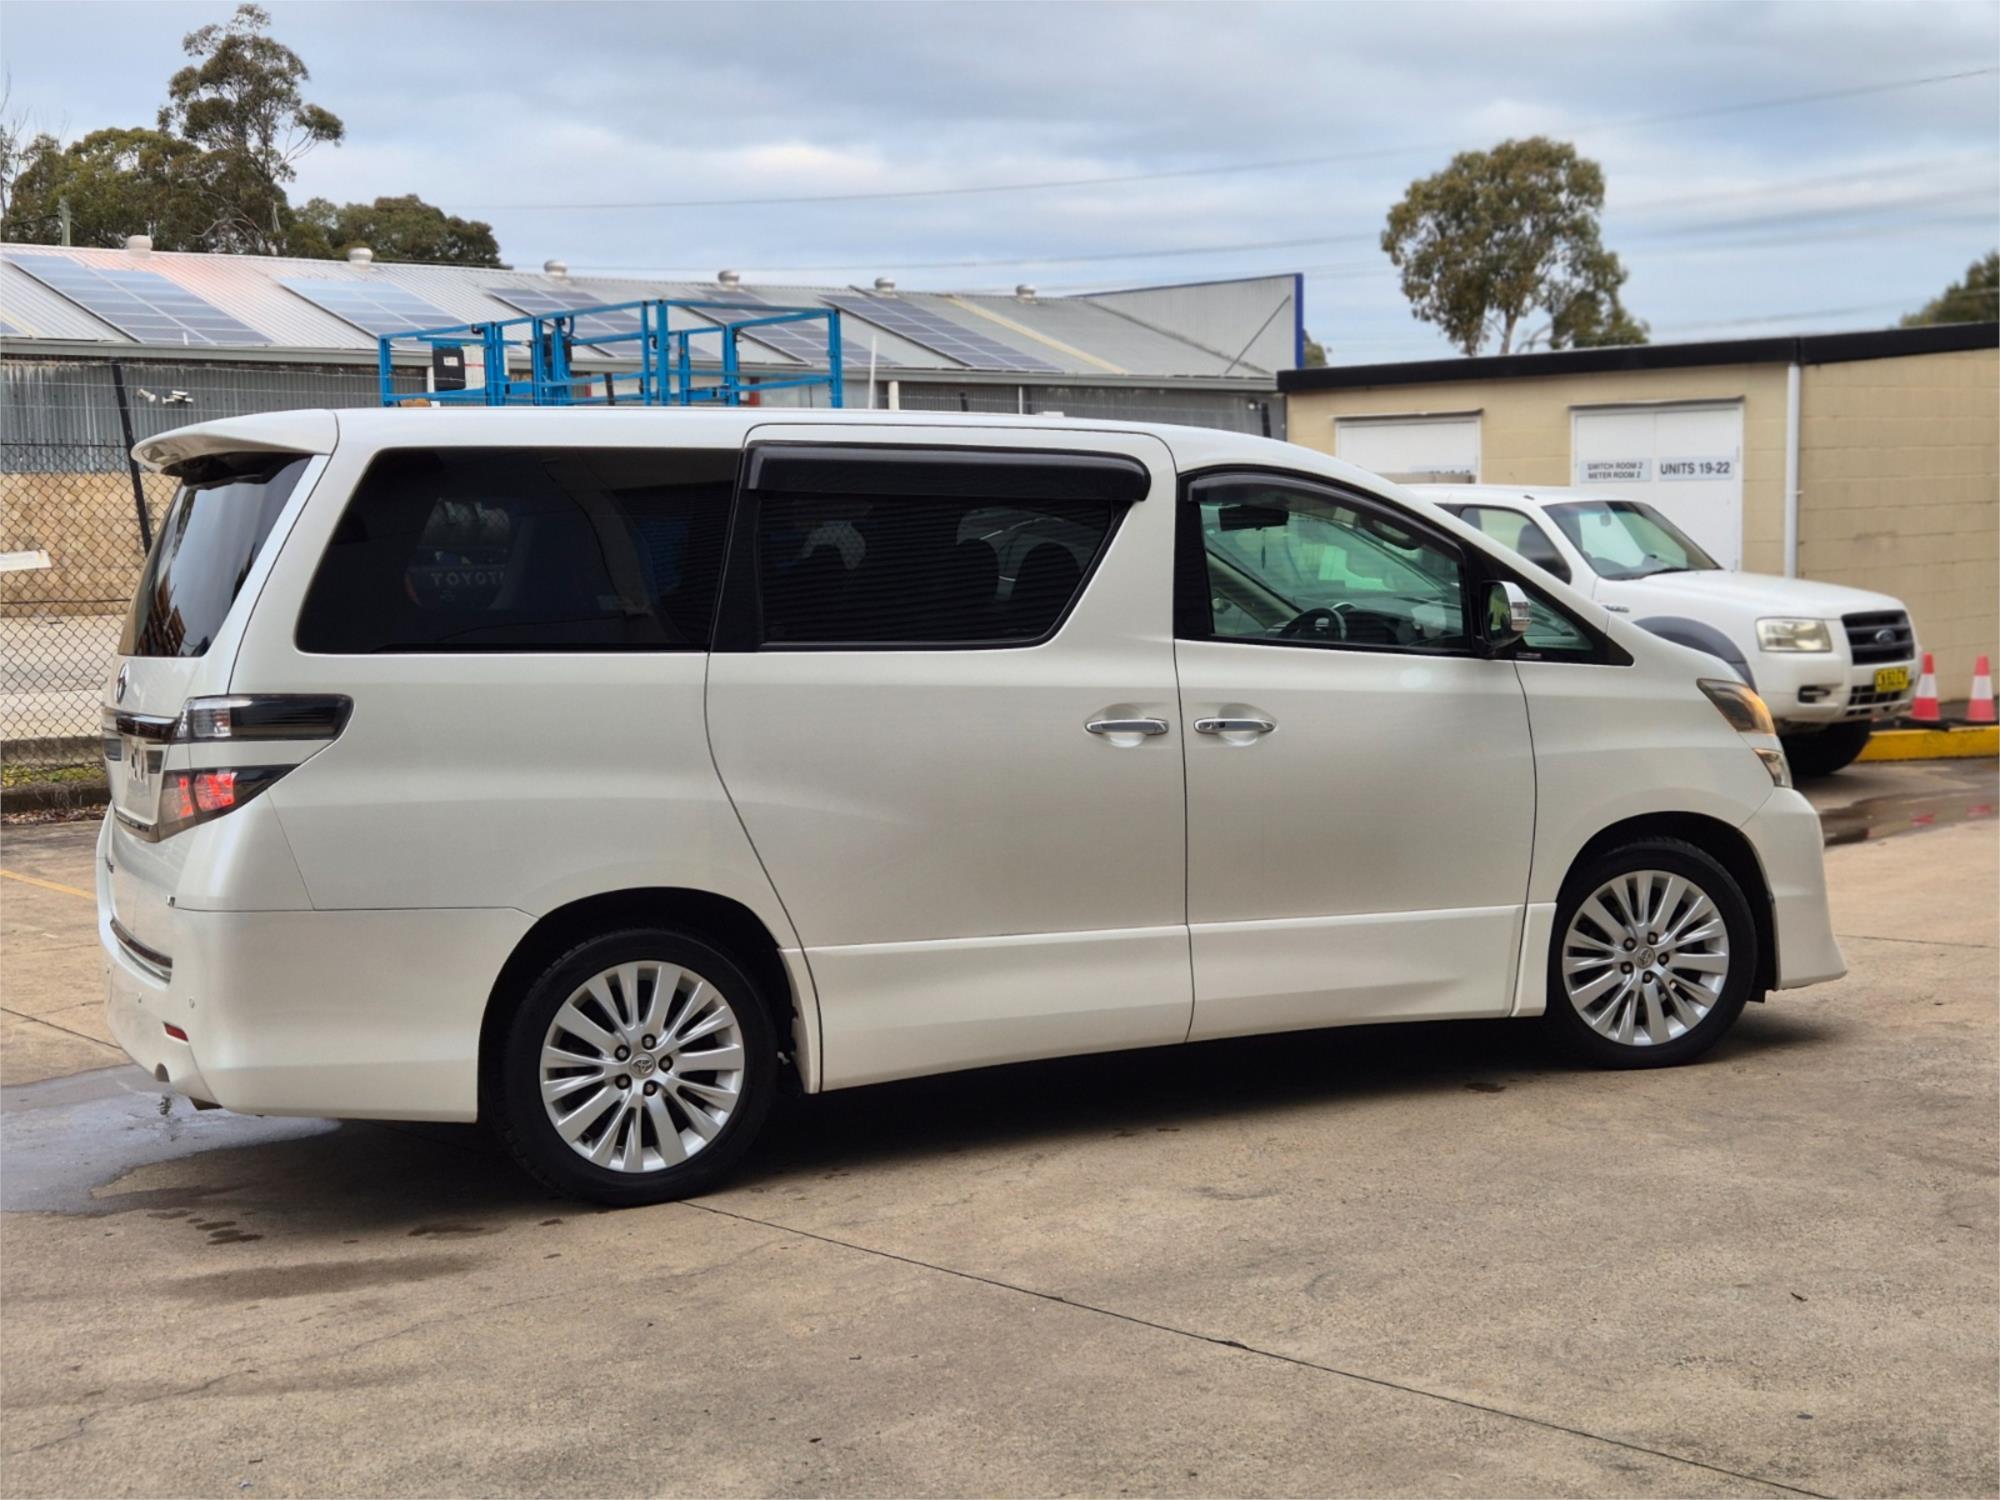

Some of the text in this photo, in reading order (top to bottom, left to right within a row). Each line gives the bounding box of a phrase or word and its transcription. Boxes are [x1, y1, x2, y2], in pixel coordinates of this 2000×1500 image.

[1616, 462, 1637, 470] ROOM
[1660, 462, 1730, 475] UNITS 19-22
[1588, 472, 1612, 480] METER
[1613, 471, 1635, 479] ROOM
